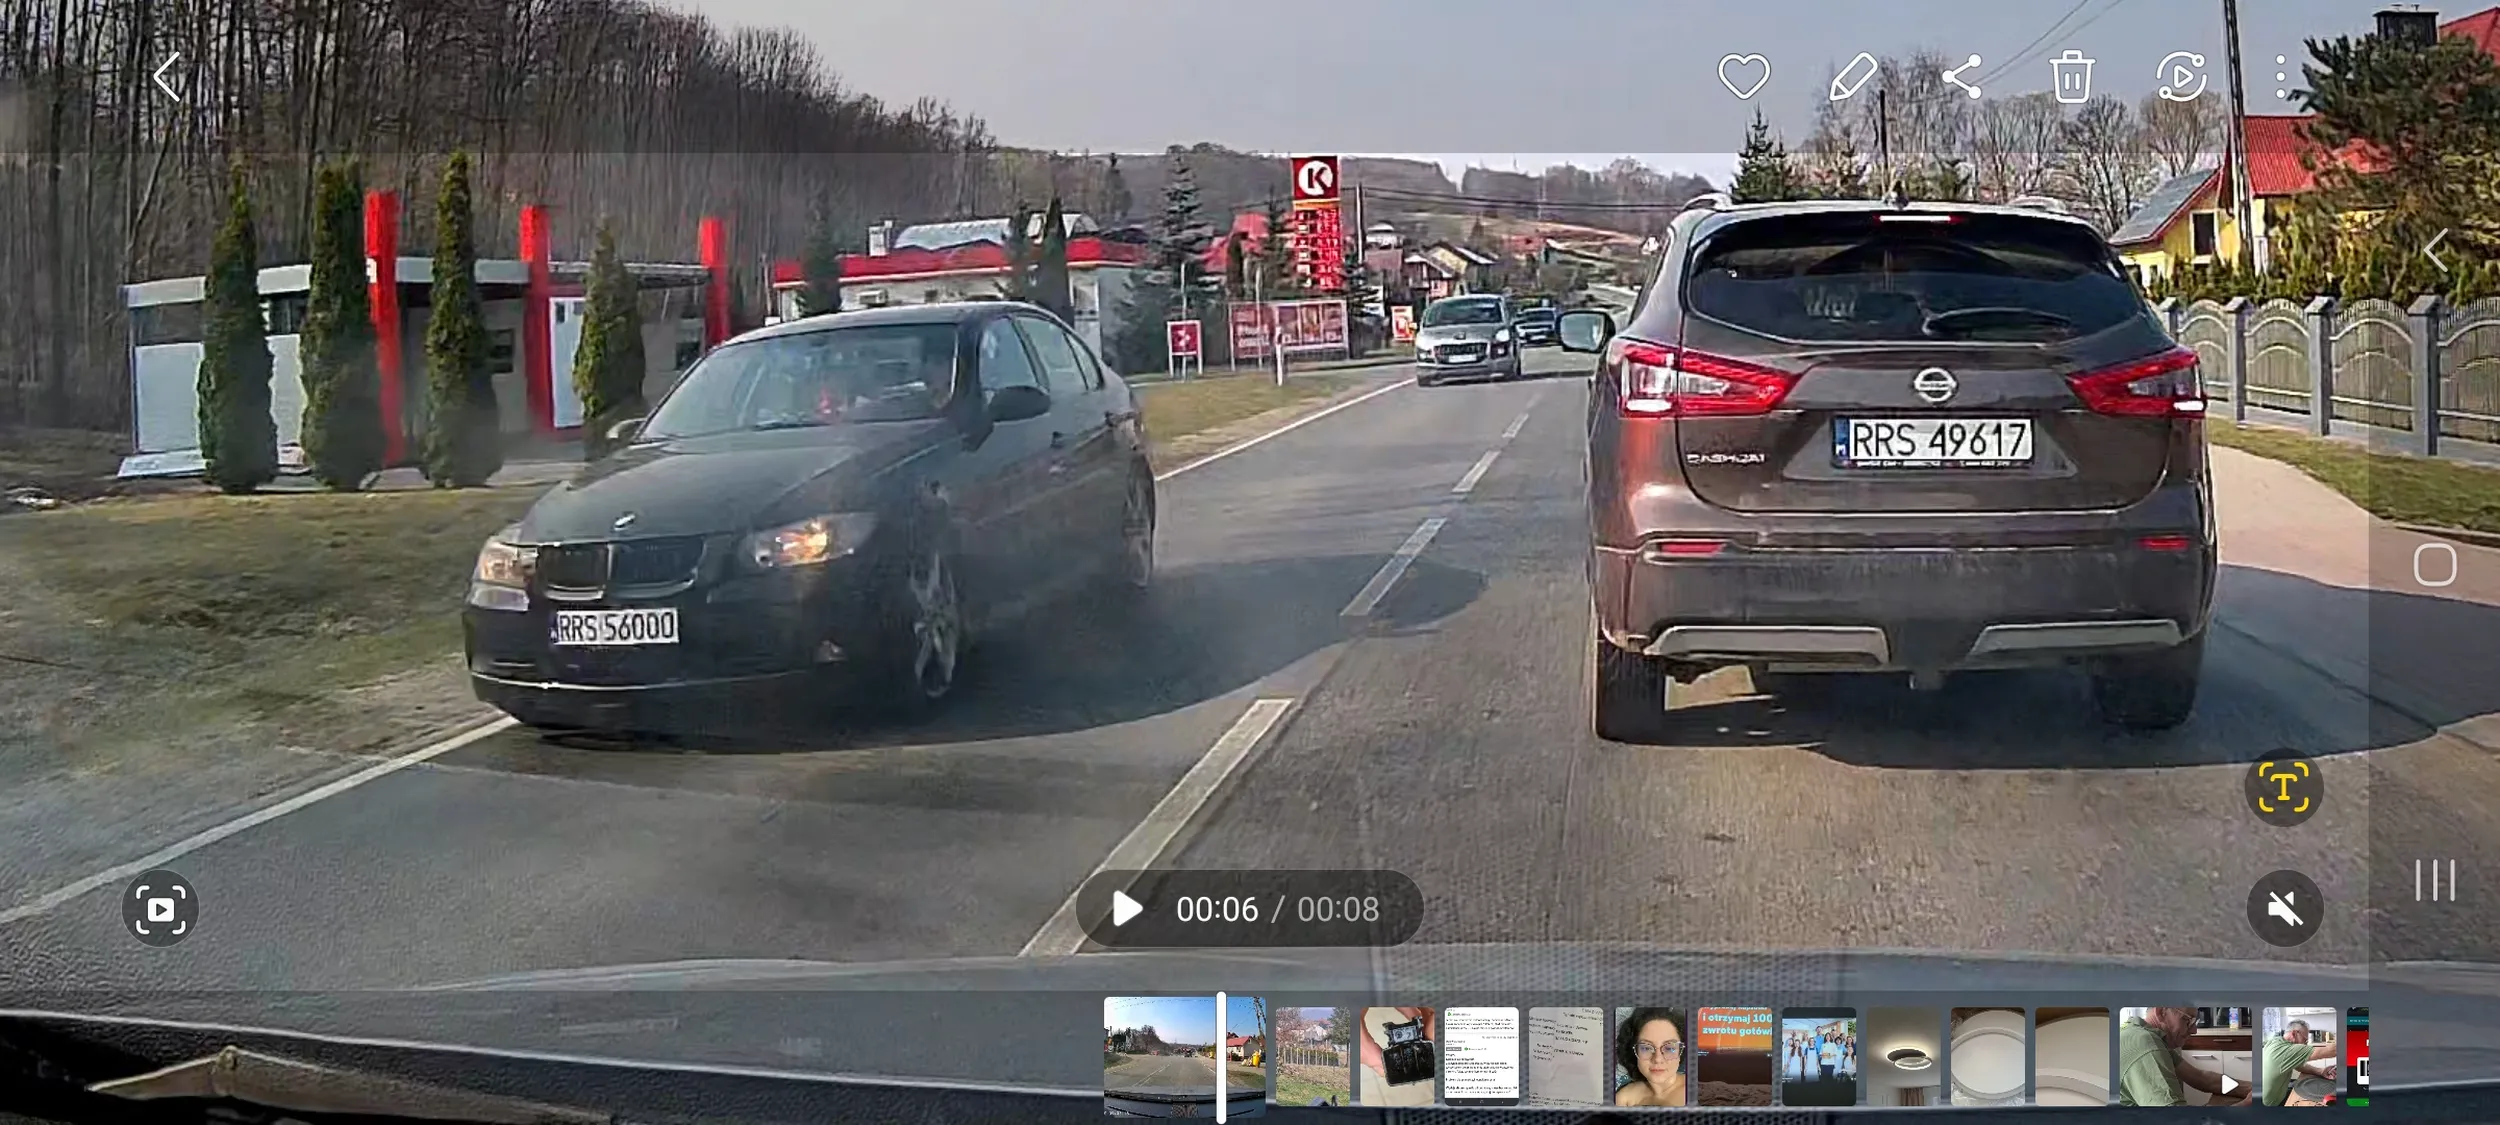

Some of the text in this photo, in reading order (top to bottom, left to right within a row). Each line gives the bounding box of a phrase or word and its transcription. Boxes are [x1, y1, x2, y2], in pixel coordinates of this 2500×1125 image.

[1853, 422, 2027, 457] RRS 49617
[559, 611, 675, 642] RRS 56000
